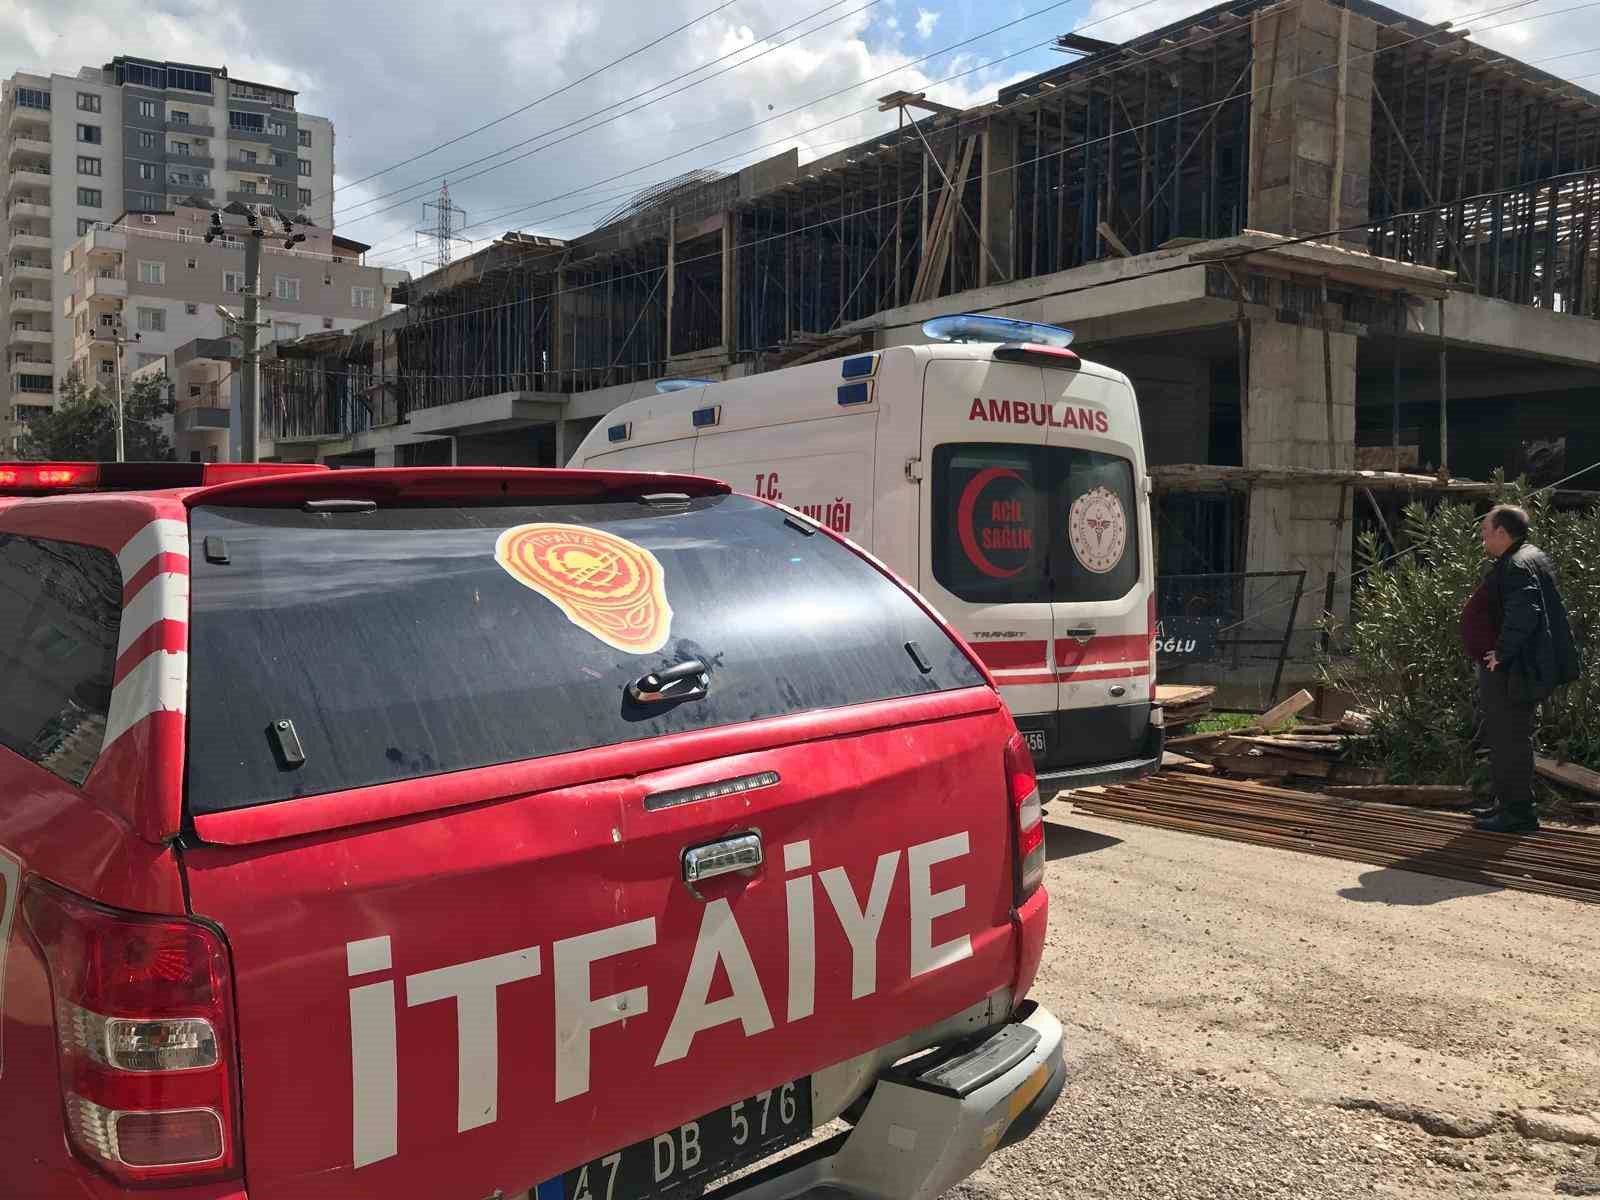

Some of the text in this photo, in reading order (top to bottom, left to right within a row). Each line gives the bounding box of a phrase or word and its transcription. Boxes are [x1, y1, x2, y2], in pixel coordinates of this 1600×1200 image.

[969, 398, 1109, 433] AMBULANS
[755, 472, 782, 500] T.C.
[973, 631, 1027, 639] TRANSIT
[346, 831, 973, 1169] İTFAİYE
[653, 1121, 701, 1183] DB
[730, 1081, 796, 1145] 576
